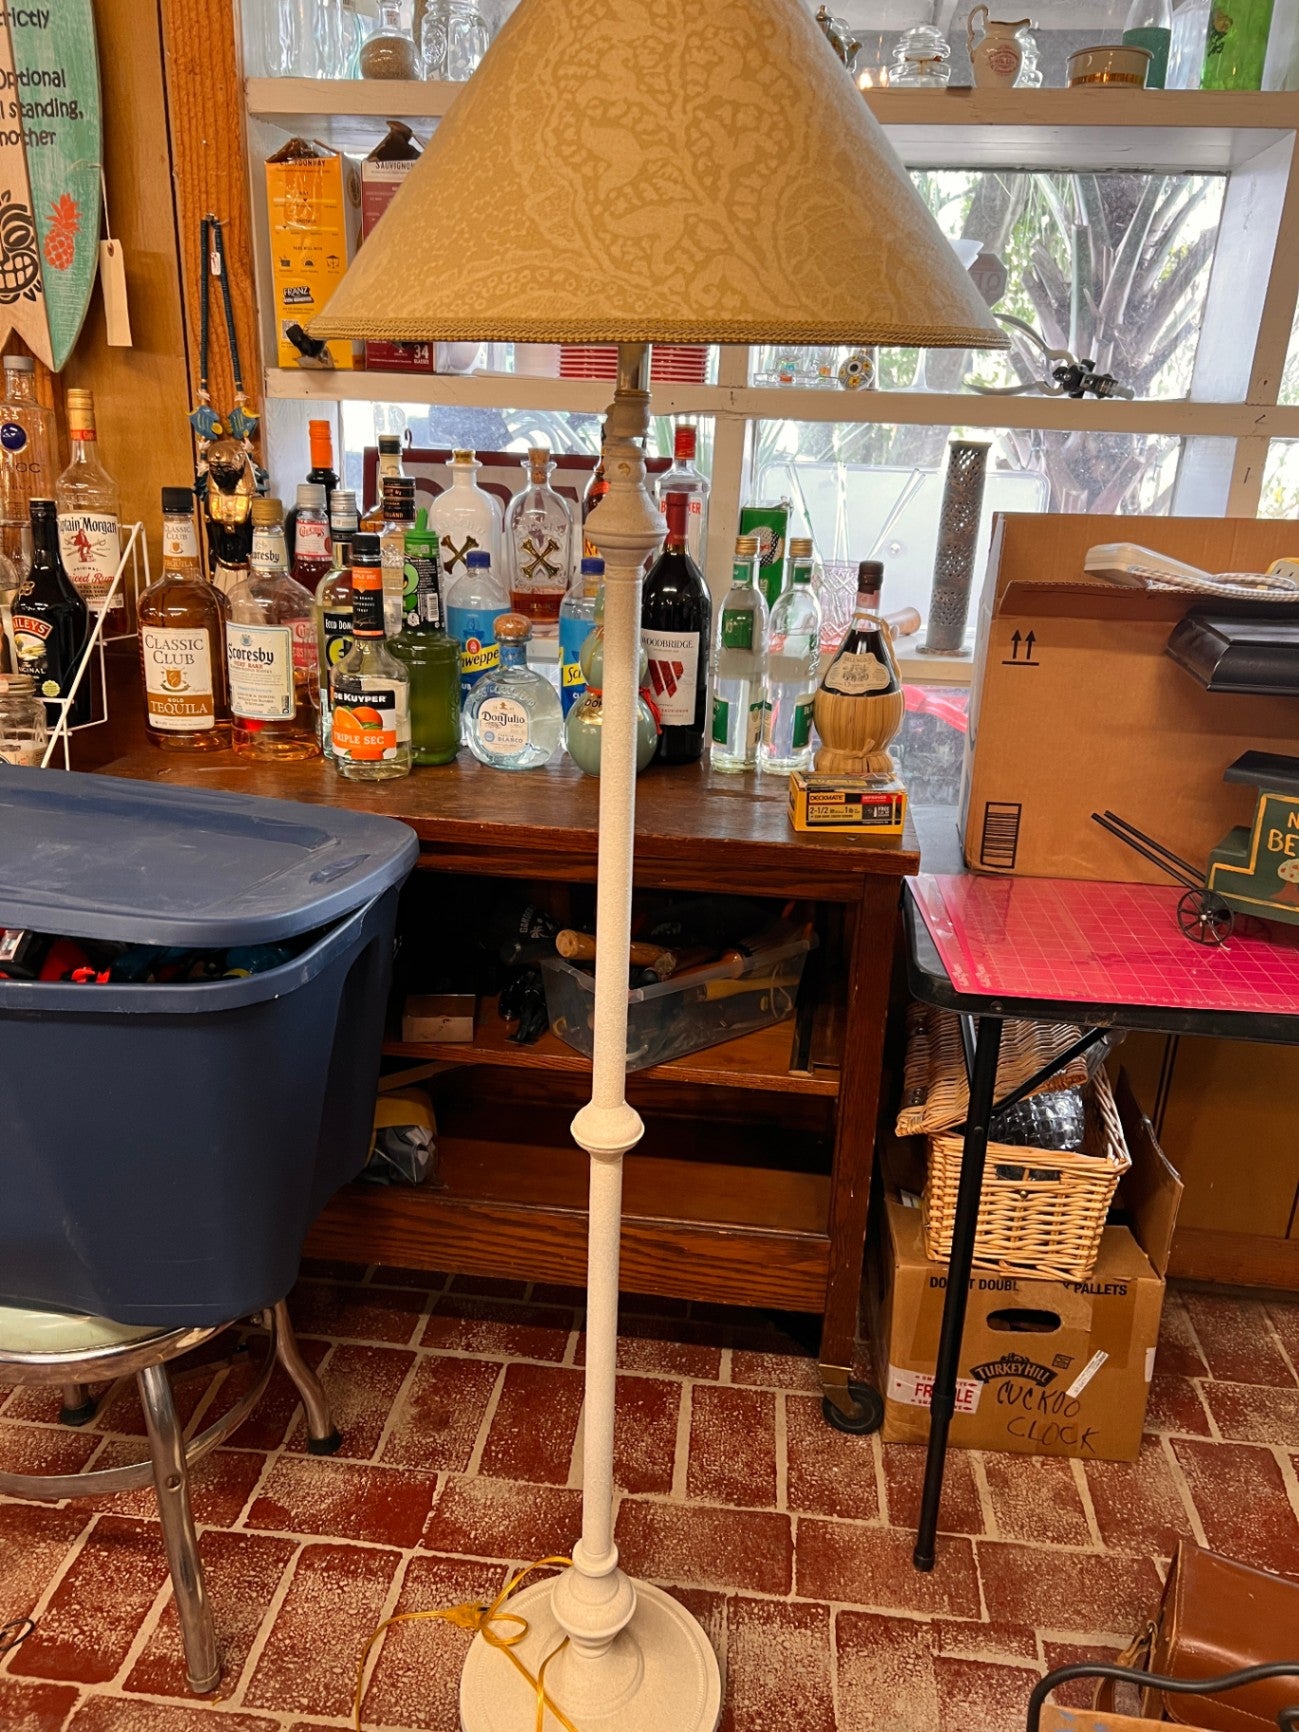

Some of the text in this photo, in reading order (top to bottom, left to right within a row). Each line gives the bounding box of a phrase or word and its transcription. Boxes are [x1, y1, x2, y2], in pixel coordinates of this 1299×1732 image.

[0, 67, 66, 89] Optional
[9, 98, 83, 120] standing,
[0, 128, 56, 148] nother
[283, 287, 308, 297] FRANZ
[414, 344, 429, 359] 34
[80, 517, 117, 534] Morgan
[165, 526, 191, 534] CLASSIC
[166, 532, 189, 540] CLUB
[252, 550, 280, 563] oresby
[92, 573, 115, 584] Rum
[13, 618, 49, 634] ILEYS
[145, 633, 204, 651] CLASSIC
[152, 650, 196, 665] CLUB
[343, 692, 387, 703] KUYPER
[150, 700, 208, 715] TEQUILA
[334, 731, 385, 745] TRIPLE SEC
[809, 806, 829, 814] 2-1/2
[930, 1276, 947, 1288] DO
[978, 1278, 1020, 1292] DOUBL
[1074, 1283, 1128, 1296] PALLETS
[974, 1362, 1026, 1380] TURKEY
[1024, 1363, 1050, 1384] HILL
[915, 1382, 974, 1404] FRLE
[997, 1380, 1081, 1418] CUCKOO
[1006, 1416, 1100, 1453] CLOCK
